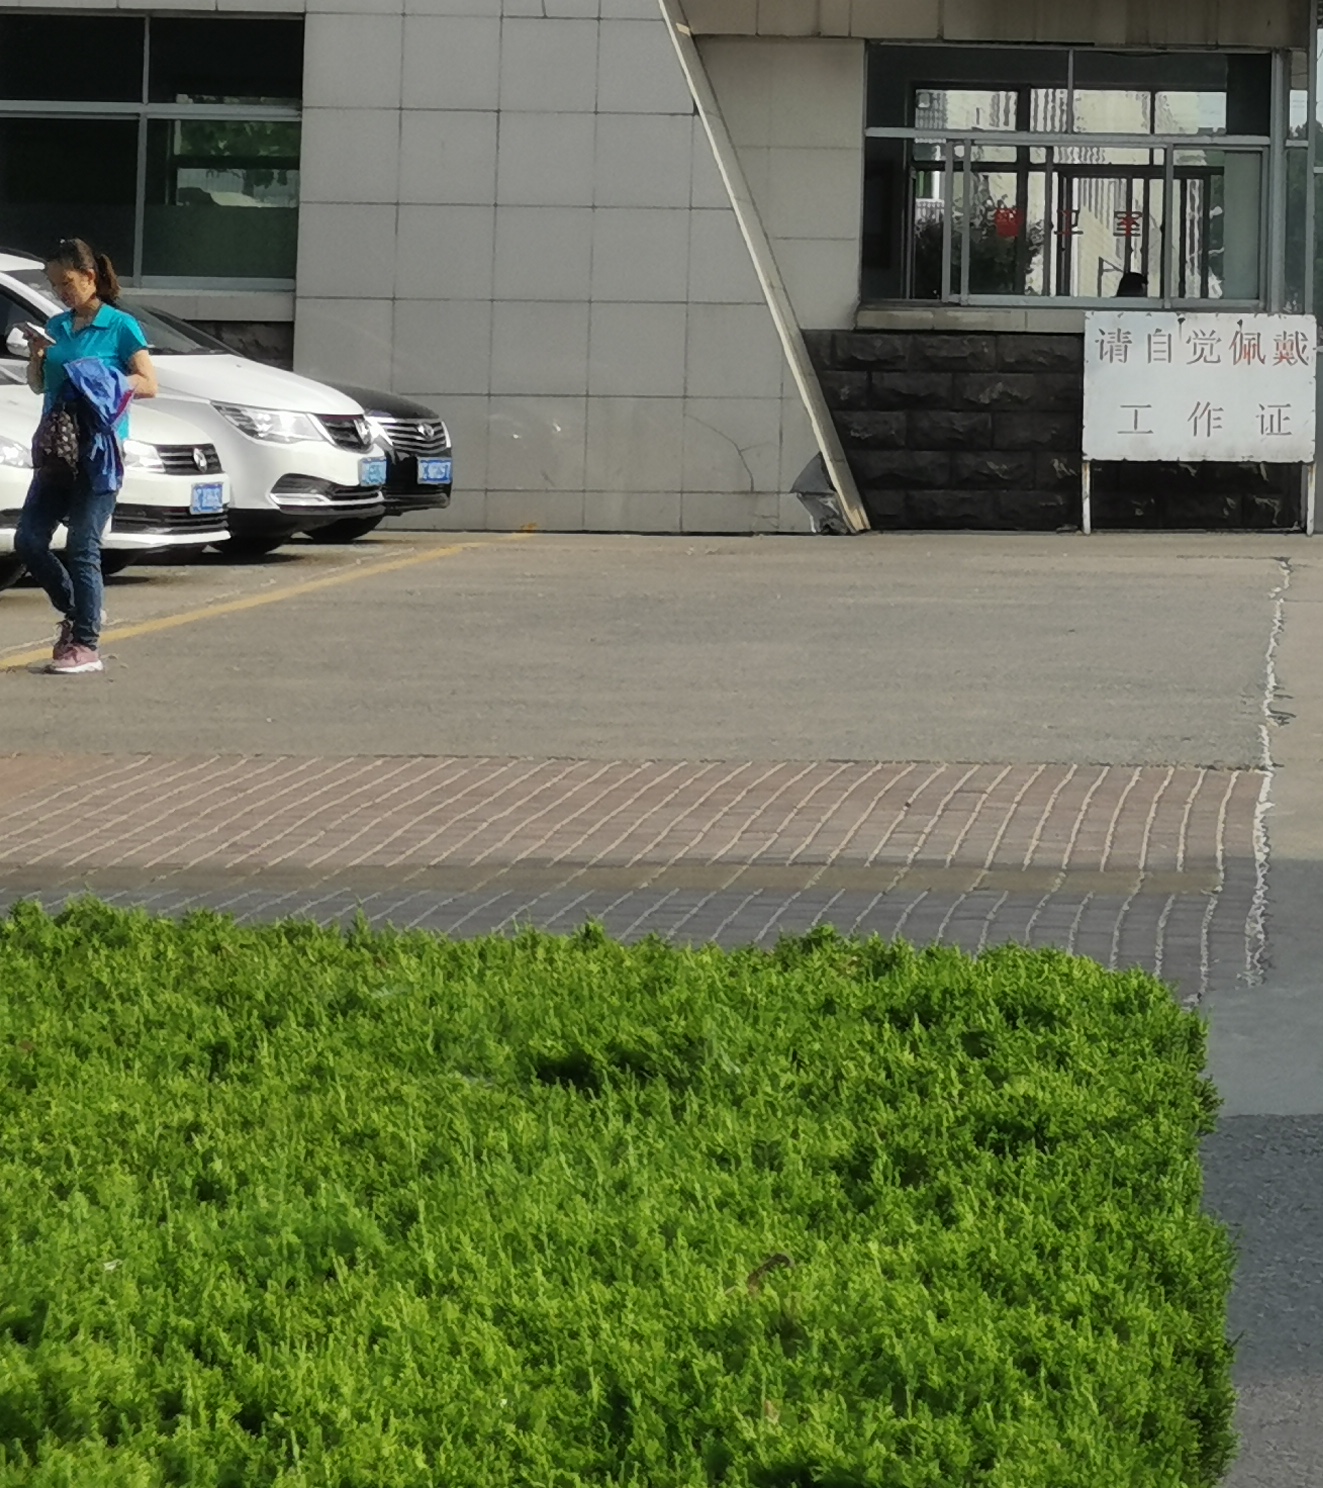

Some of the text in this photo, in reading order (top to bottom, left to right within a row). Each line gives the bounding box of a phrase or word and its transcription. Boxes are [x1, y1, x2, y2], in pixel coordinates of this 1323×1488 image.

[1095, 327, 1309, 367] 请自觉佩戴
[1117, 401, 1293, 438] 工作证
